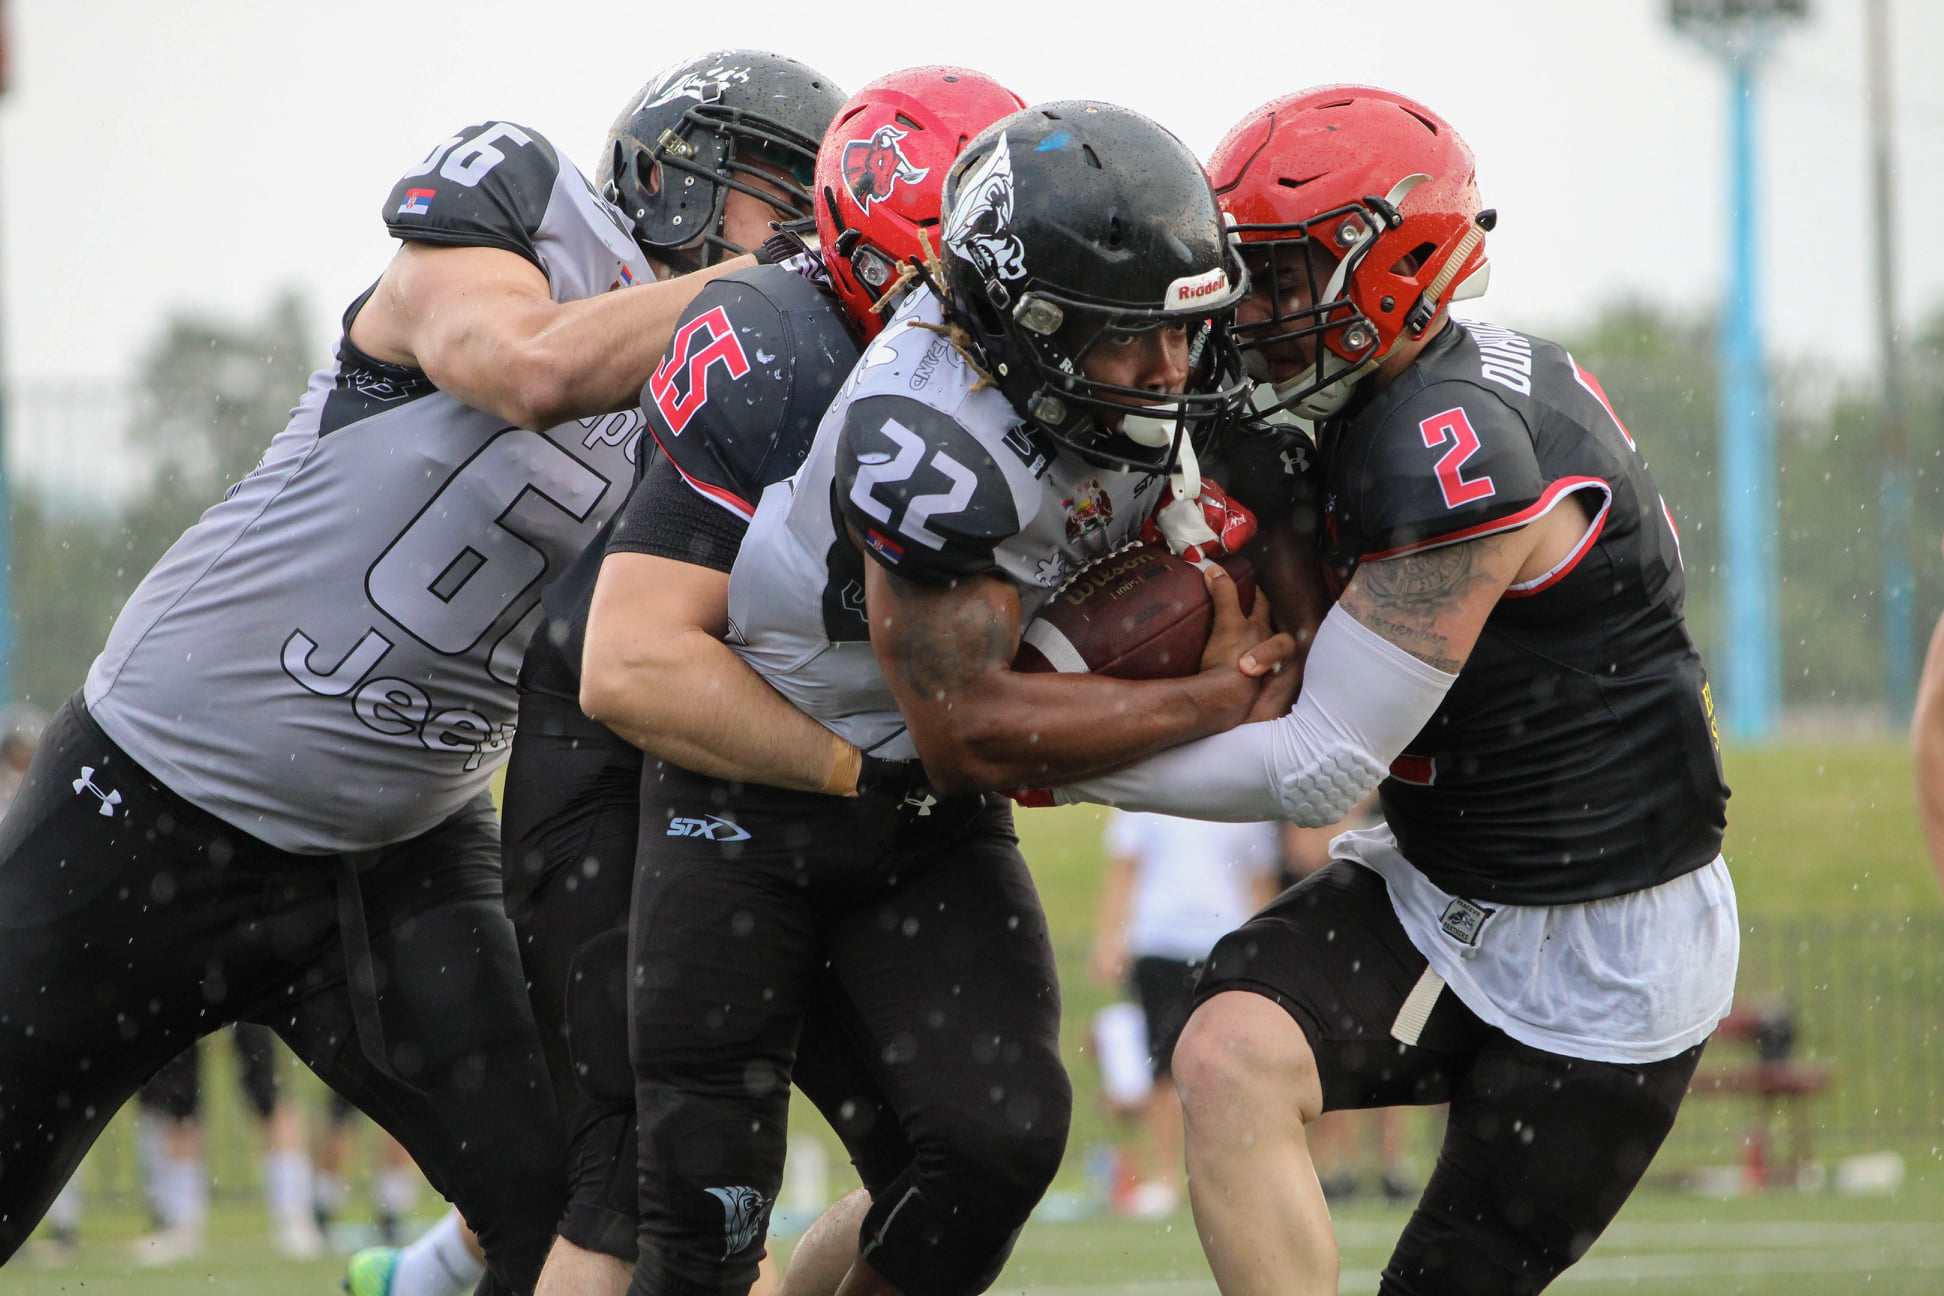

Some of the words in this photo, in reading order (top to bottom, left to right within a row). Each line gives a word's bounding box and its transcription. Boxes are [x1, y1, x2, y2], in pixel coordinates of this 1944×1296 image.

[1179, 274, 1226, 300] Riddell
[849, 417, 978, 551] 22
[1418, 406, 1496, 510] 2
[364, 425, 612, 688] 6
[1065, 553, 1156, 605] Wilson
[666, 818, 724, 840] STX
